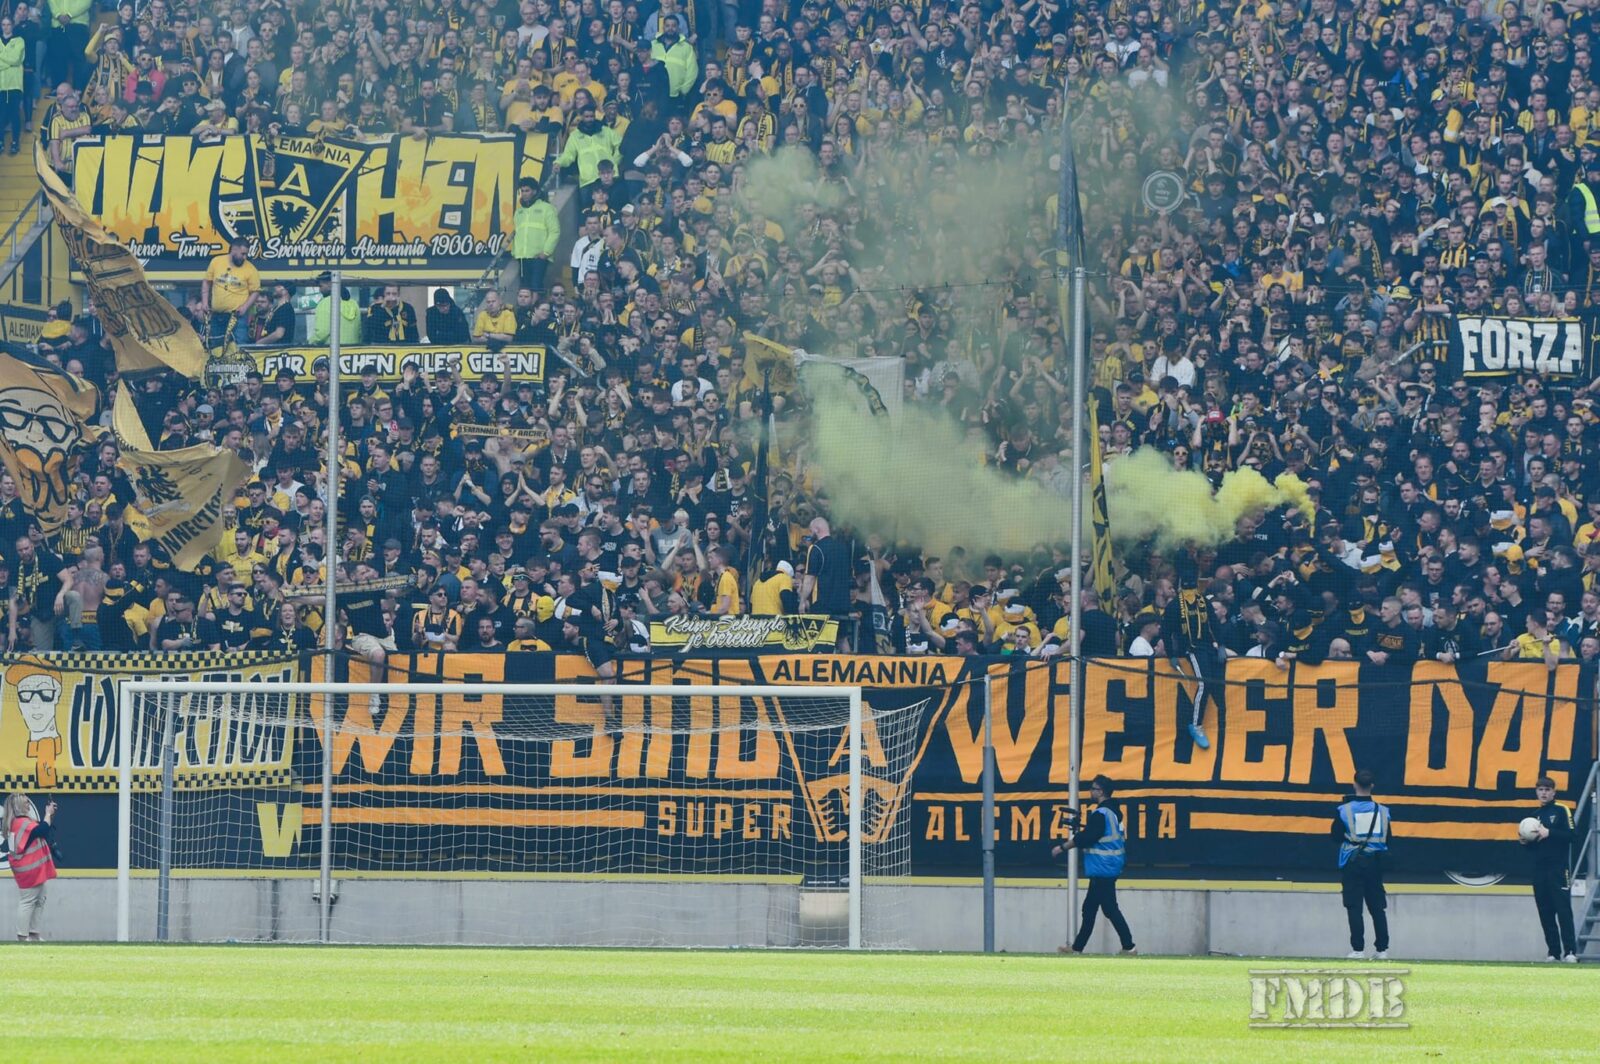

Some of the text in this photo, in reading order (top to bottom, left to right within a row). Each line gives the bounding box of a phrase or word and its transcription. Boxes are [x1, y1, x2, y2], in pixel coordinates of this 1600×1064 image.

[262, 235, 346, 258] Sportverein
[351, 235, 426, 257] Alemannia
[1458, 318, 1583, 373] FORZA
[264, 353, 306, 377] FÜR
[773, 658, 950, 686] ALEMANNIA
[1404, 660, 1580, 791] DA!
[657, 801, 793, 840] SUPER
